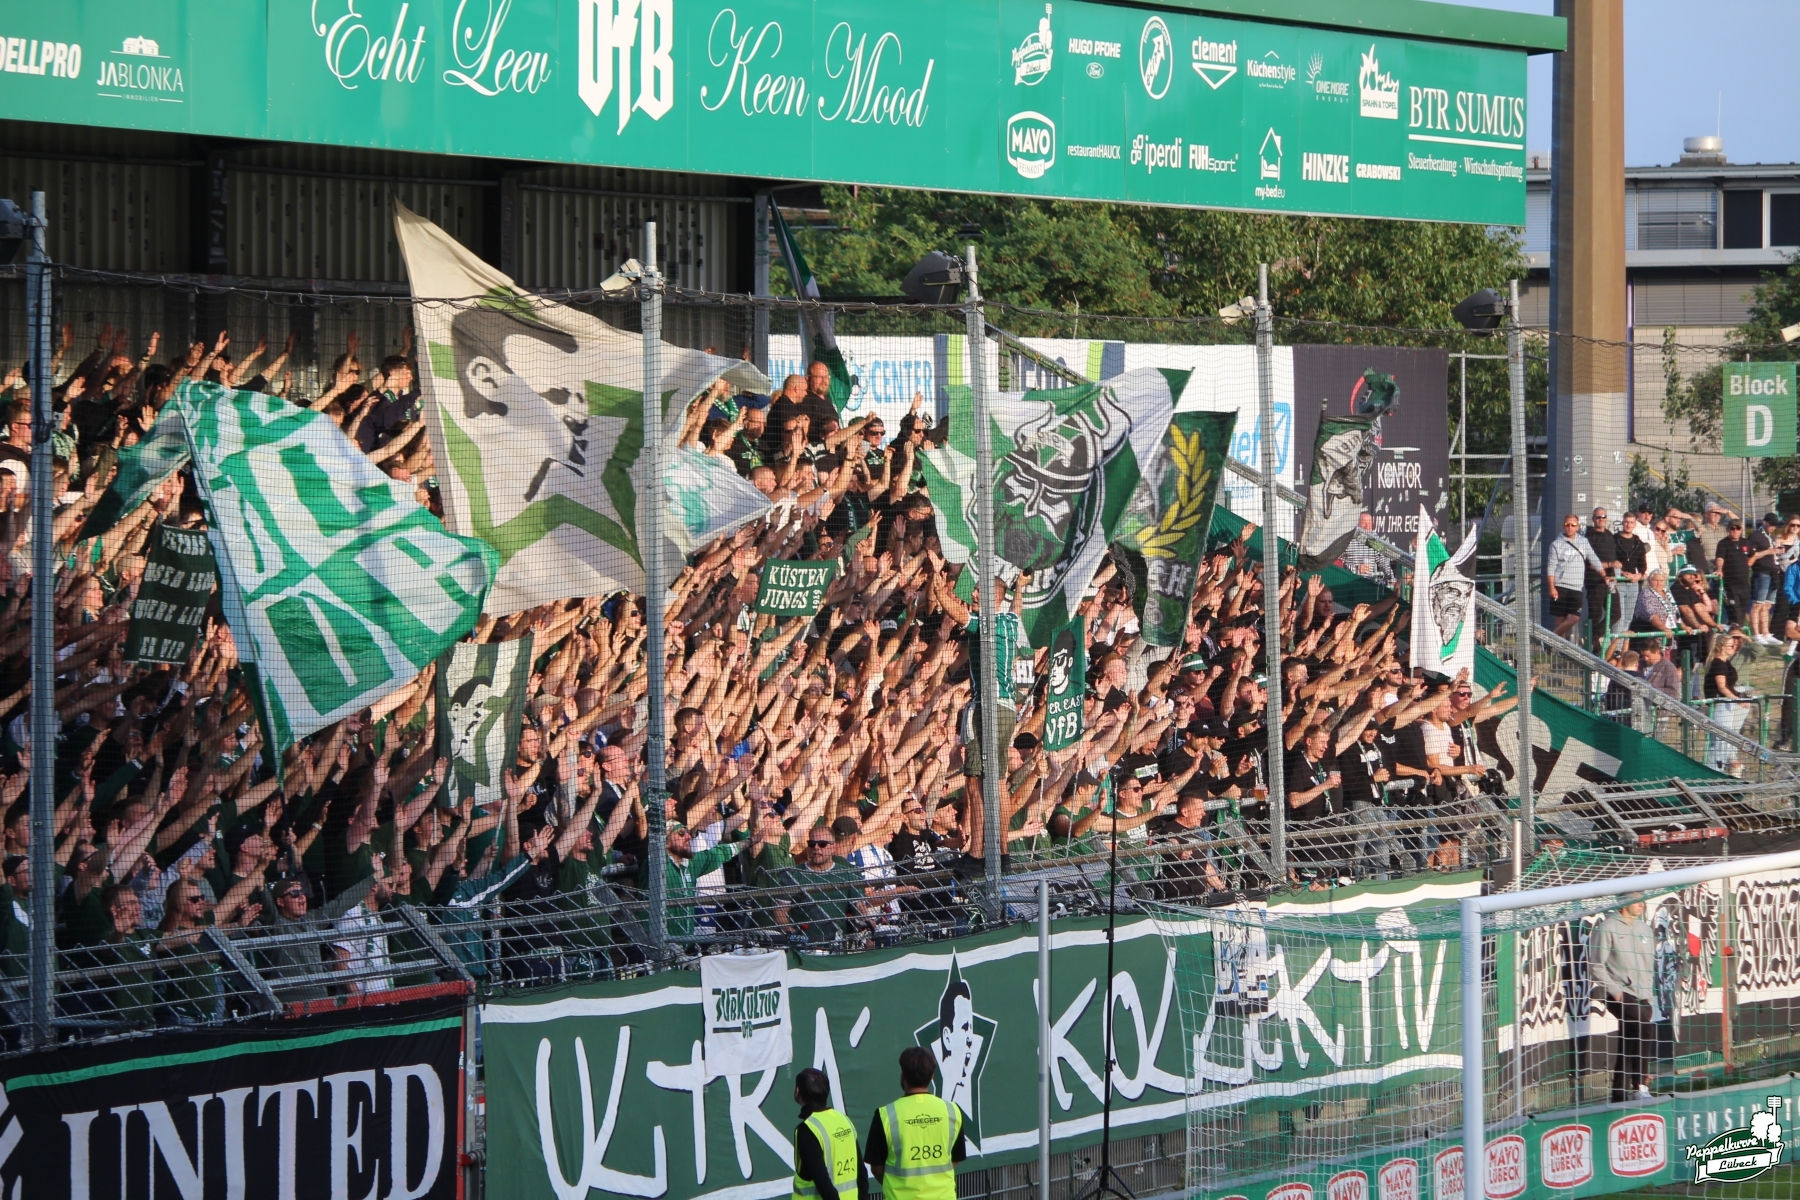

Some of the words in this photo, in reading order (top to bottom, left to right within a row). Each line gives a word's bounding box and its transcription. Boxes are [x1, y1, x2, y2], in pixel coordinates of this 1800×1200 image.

[312, 0, 426, 89] Echt
[443, 0, 551, 96] Leev
[1068, 38, 1093, 55] HUGO
[1094, 41, 1121, 58] PFOHE
[1192, 36, 1238, 63] clement
[97, 61, 184, 92] JABLONKA
[701, 9, 810, 116] Keen
[818, 22, 934, 127] Mood
[1247, 59, 1296, 84] Küchenstyle
[1362, 99, 1378, 107] SPAHN
[1382, 101, 1397, 110] TOPEL
[1409, 86, 1450, 130] BTR
[1456, 91, 1524, 138] SUMUS
[1012, 126, 1050, 155] MAYO
[1067, 144, 1121, 160] restaurantHAUCK
[1145, 134, 1182, 174] iperdi
[1019, 161, 1043, 174] FEINKOST
[1303, 152, 1349, 183] HINZKE
[1356, 163, 1401, 180] GRABOWSKI
[1408, 152, 1457, 177] Steuerberatung
[1464, 157, 1523, 182] Wirtschaftsprüfung
[1255, 184, 1285, 200] my-bed.eu
[871, 360, 933, 404] CENTER
[1730, 374, 1788, 396] Block
[1746, 404, 1773, 447] D
[1378, 461, 1422, 489] KONTOR
[1387, 515, 1402, 533] IHR
[768, 565, 829, 588] KÜSTEN
[760, 589, 809, 609] JUNGS
[62, 1063, 445, 1200] UNITED
[1618, 1123, 1657, 1145] MAYO
[911, 1144, 943, 1161] 288
[1489, 1145, 1520, 1166] MAYO
[1550, 1133, 1584, 1156] MAYO
[1618, 1143, 1657, 1161] LÜBECK
[1489, 1165, 1520, 1184] LÜBECK
[1550, 1153, 1583, 1173] LÜBECK
[1385, 1168, 1412, 1192] MAYO
